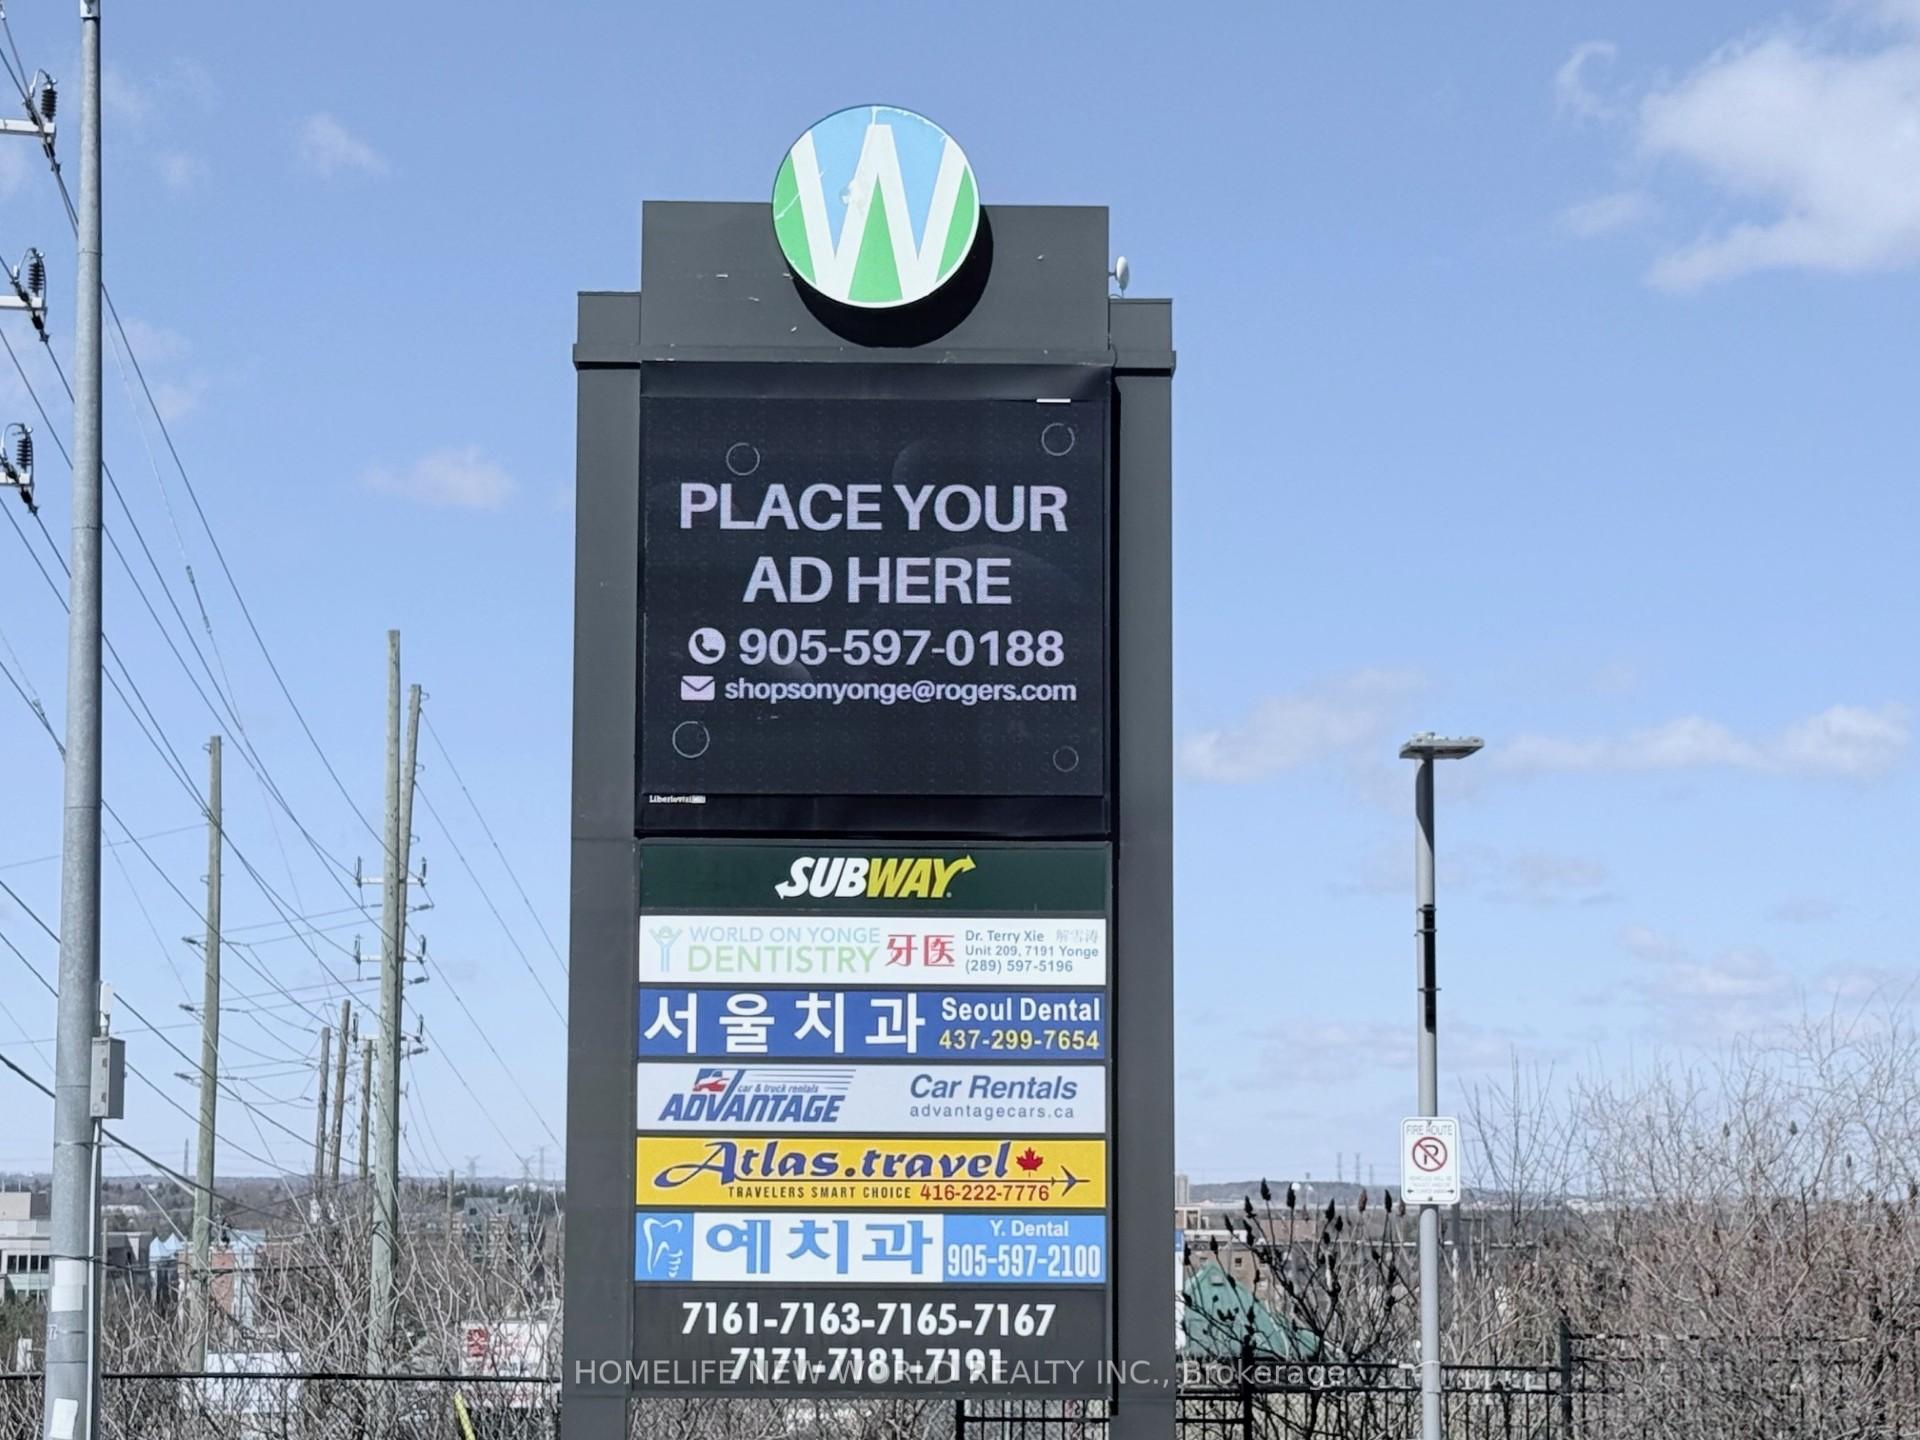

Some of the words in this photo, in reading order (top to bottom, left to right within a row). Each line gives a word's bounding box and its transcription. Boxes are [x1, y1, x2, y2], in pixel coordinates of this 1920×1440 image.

[789, 123, 968, 306] W
[680, 482, 883, 531] PLACE
[892, 484, 1069, 532] YOUR
[742, 556, 833, 603] AD
[847, 557, 1012, 604] HERE
[738, 628, 1065, 667] 905-597-0188
[724, 677, 1078, 705] shopsonyonge@rogers.com
[775, 855, 976, 899] SUBWAY
[688, 926, 764, 943] WORLD
[769, 927, 801, 943] ON
[806, 927, 881, 944] YONGE
[965, 930, 983, 942] Dr.
[987, 930, 1021, 945] Terry
[1024, 930, 1045, 942] Xie
[687, 945, 879, 973] DENTISTRY
[885, 934, 956, 967] 牙医
[965, 945, 992, 956] Unit
[995, 945, 1022, 957] 209,
[1025, 945, 1055, 956] 7191
[1059, 945, 1099, 959] Yonge
[965, 959, 1002, 975] (289)
[1007, 960, 1073, 972] 597-5196
[644, 992, 925, 1054] 서울치과
[941, 997, 1013, 1022] Seoul
[1019, 998, 1100, 1023] Dental
[939, 1029, 1100, 1051] 437-299-7654
[658, 1071, 846, 1123] ADVANTAGE
[737, 1085, 753, 1093] car
[754, 1084, 761, 1093] &
[764, 1084, 787, 1093] truck
[788, 1084, 819, 1093] rentals
[910, 1074, 962, 1099] Car
[968, 1074, 1077, 1100] Rentals
[909, 1103, 1075, 1120] advantagecars.ca
[653, 1140, 1010, 1187] Atlas.travel
[728, 1185, 805, 1199] TRAVELERS
[811, 1185, 856, 1199] SMART
[863, 1186, 912, 1199] CHOICE
[920, 1184, 1050, 1202] 416-222-7776
[989, 1220, 1007, 1237] Y.
[1011, 1220, 1069, 1238] Dental
[706, 1219, 932, 1275] 예치과
[947, 1244, 1100, 1278] 905-597-2100
[681, 1302, 1056, 1337] 7161-7163-7165-7167
[730, 1347, 1002, 1382] 7171-7181-7191
